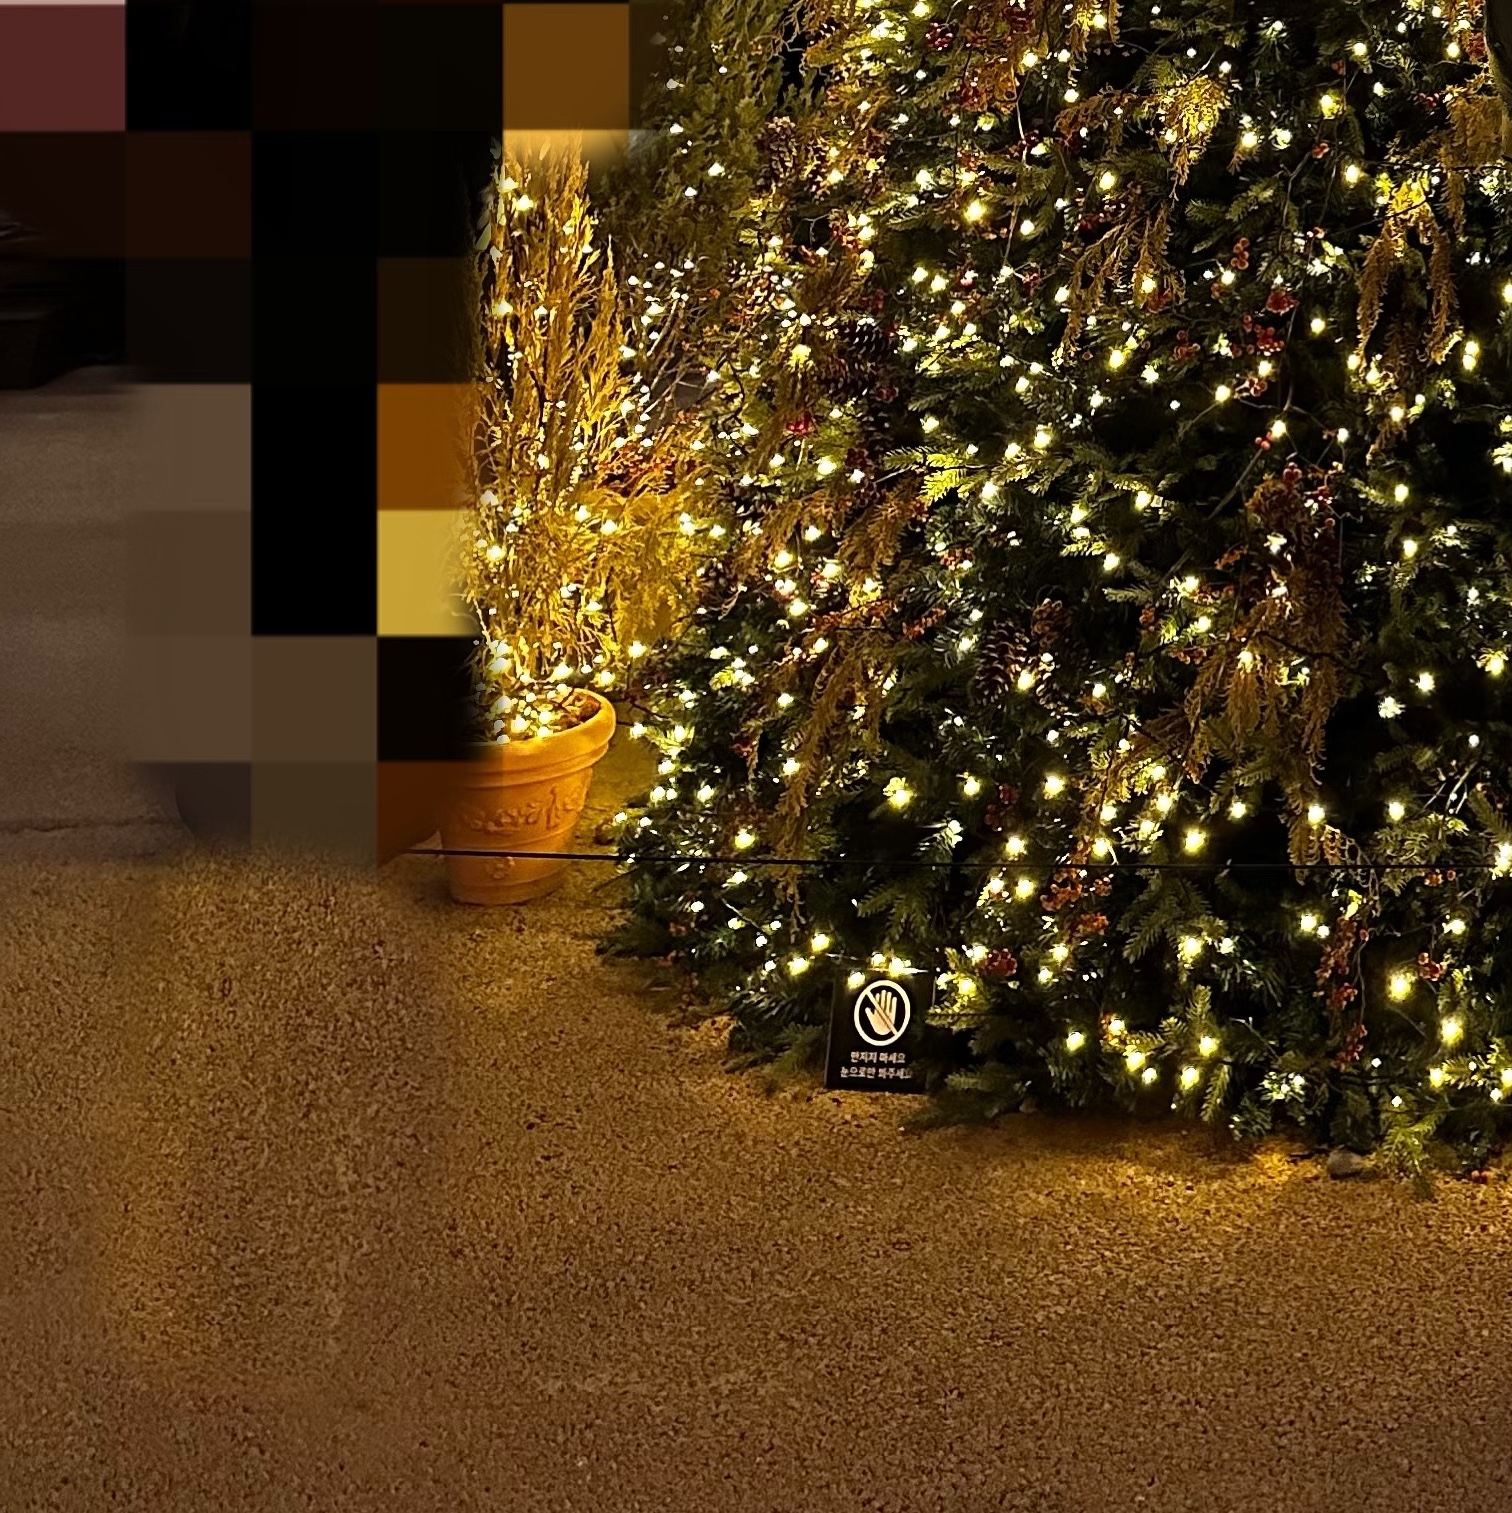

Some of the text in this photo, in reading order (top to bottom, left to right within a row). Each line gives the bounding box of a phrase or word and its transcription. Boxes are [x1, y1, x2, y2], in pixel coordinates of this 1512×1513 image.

[850, 1051, 906, 1064] 만지지 마세요
[840, 1066, 876, 1079] 눈으로만
